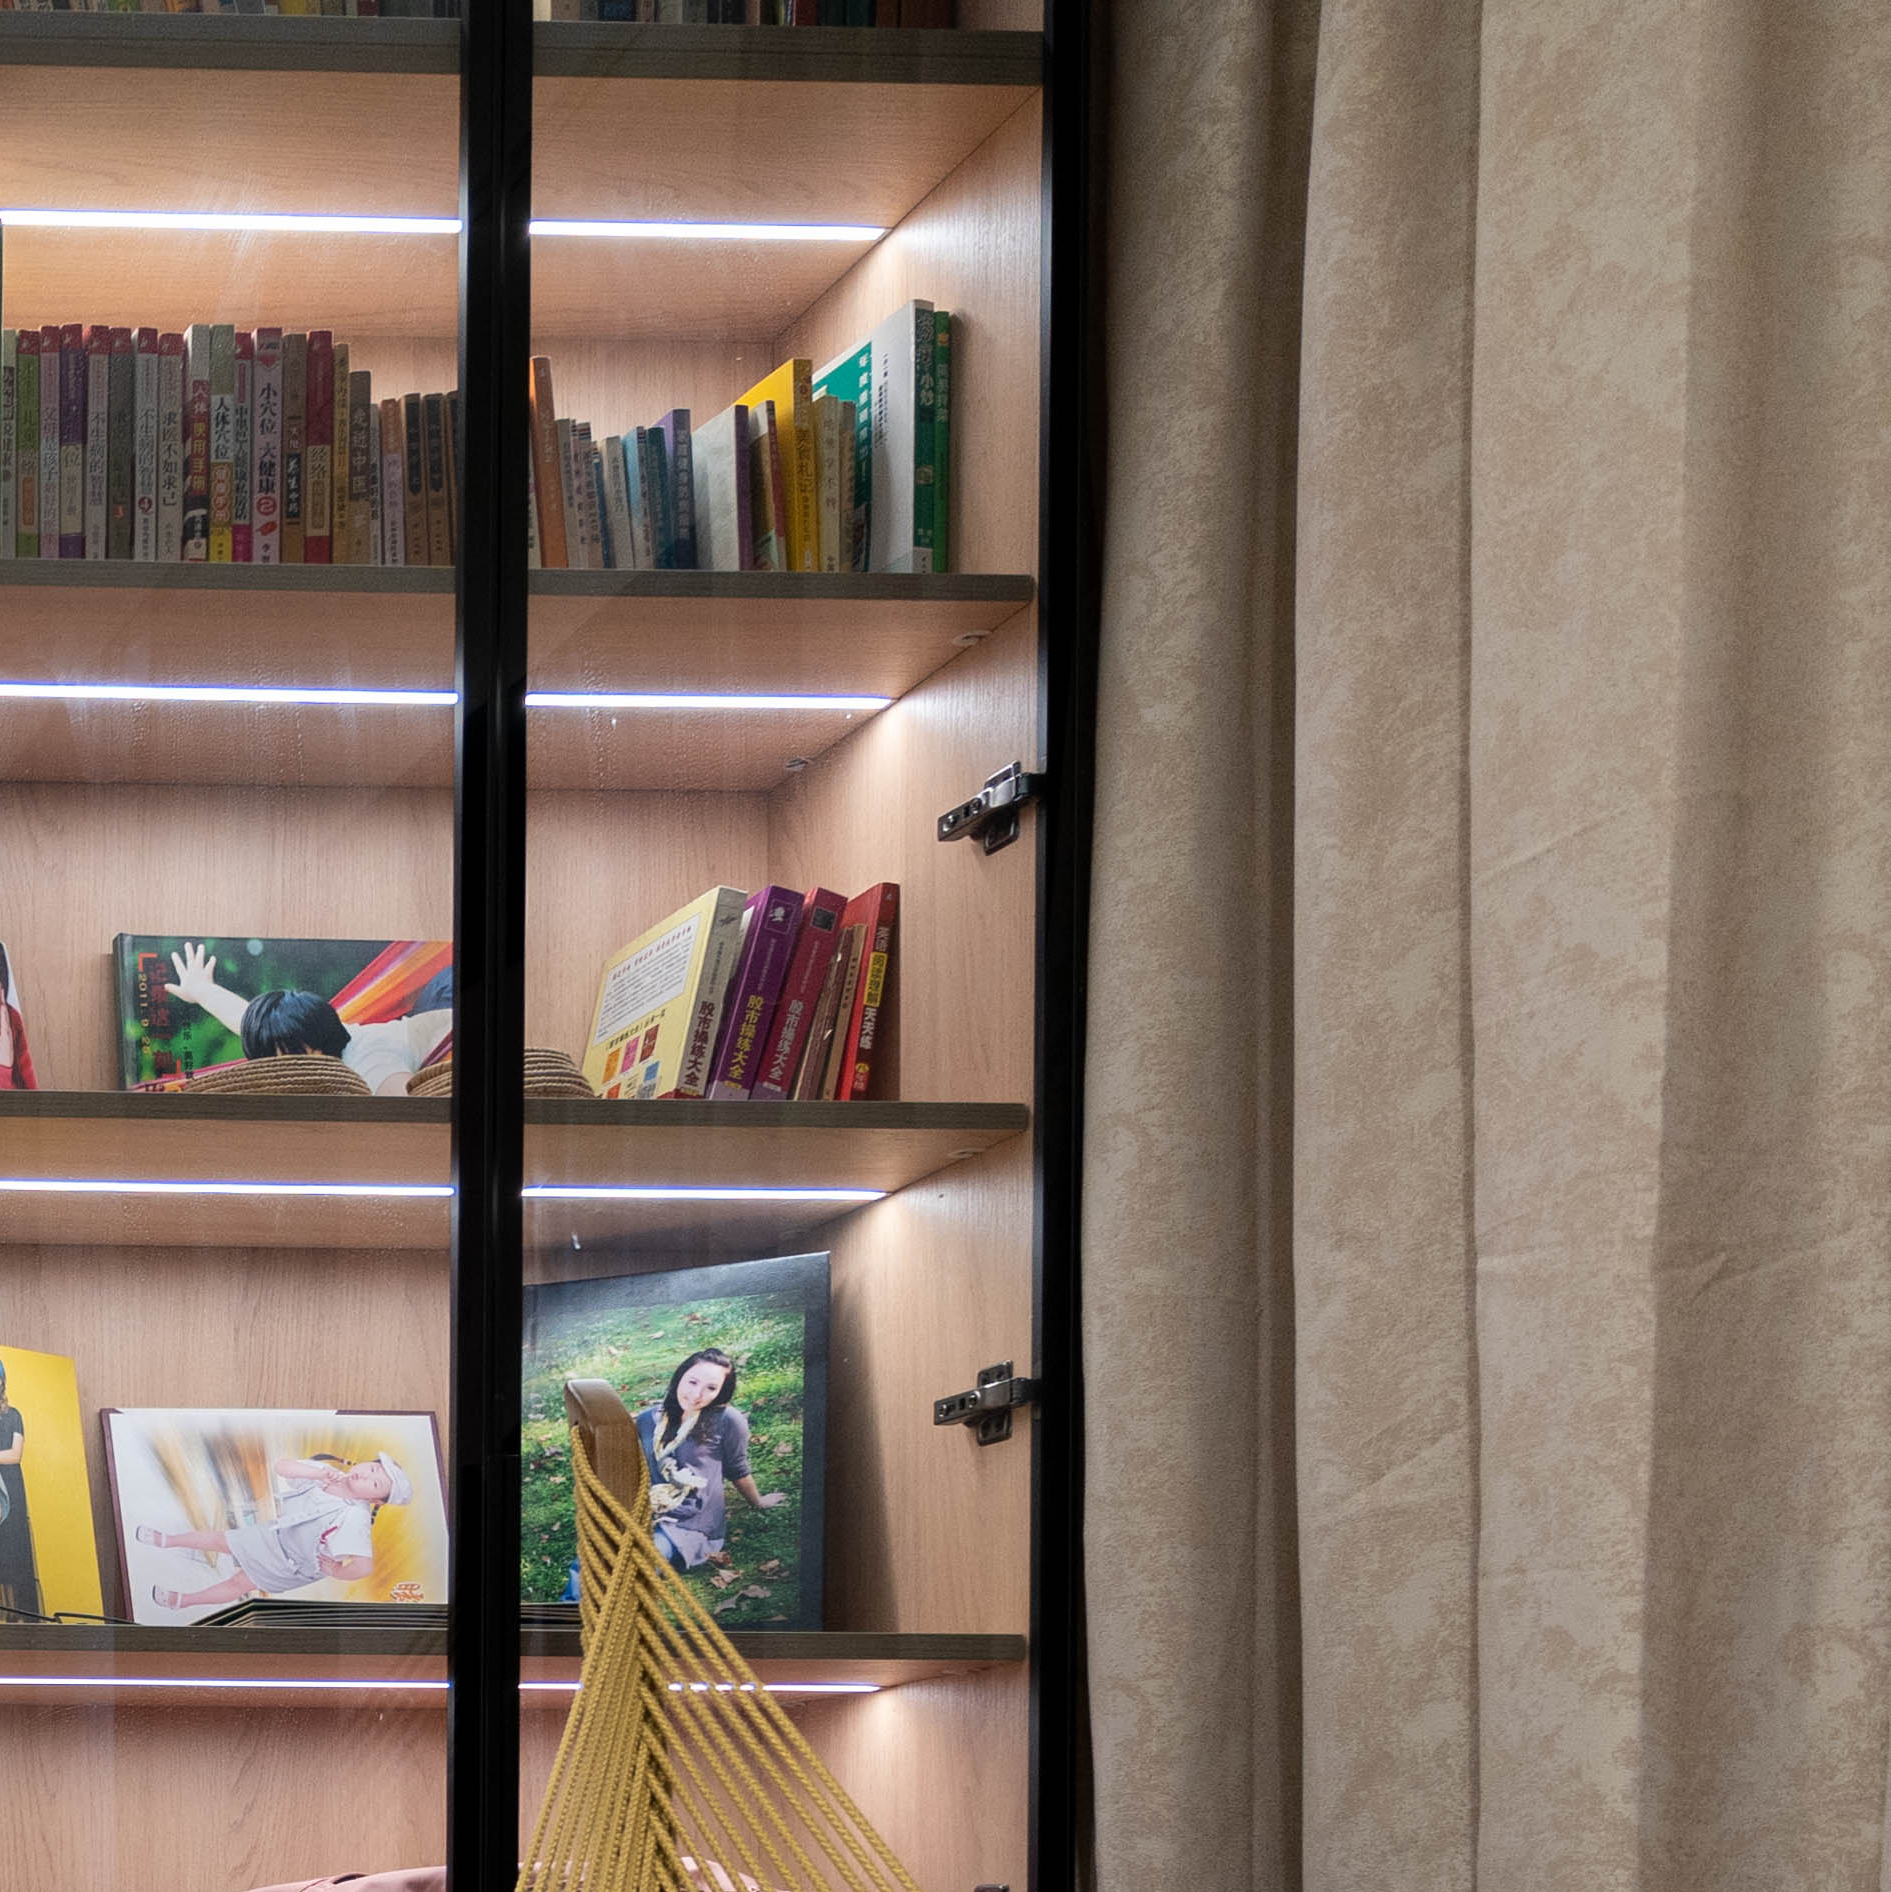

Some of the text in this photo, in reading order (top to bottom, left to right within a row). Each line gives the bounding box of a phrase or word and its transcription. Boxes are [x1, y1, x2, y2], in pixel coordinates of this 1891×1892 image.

[684, 1000, 716, 1088] 股市操练大全
[728, 994, 764, 1081] 股市操练大全
